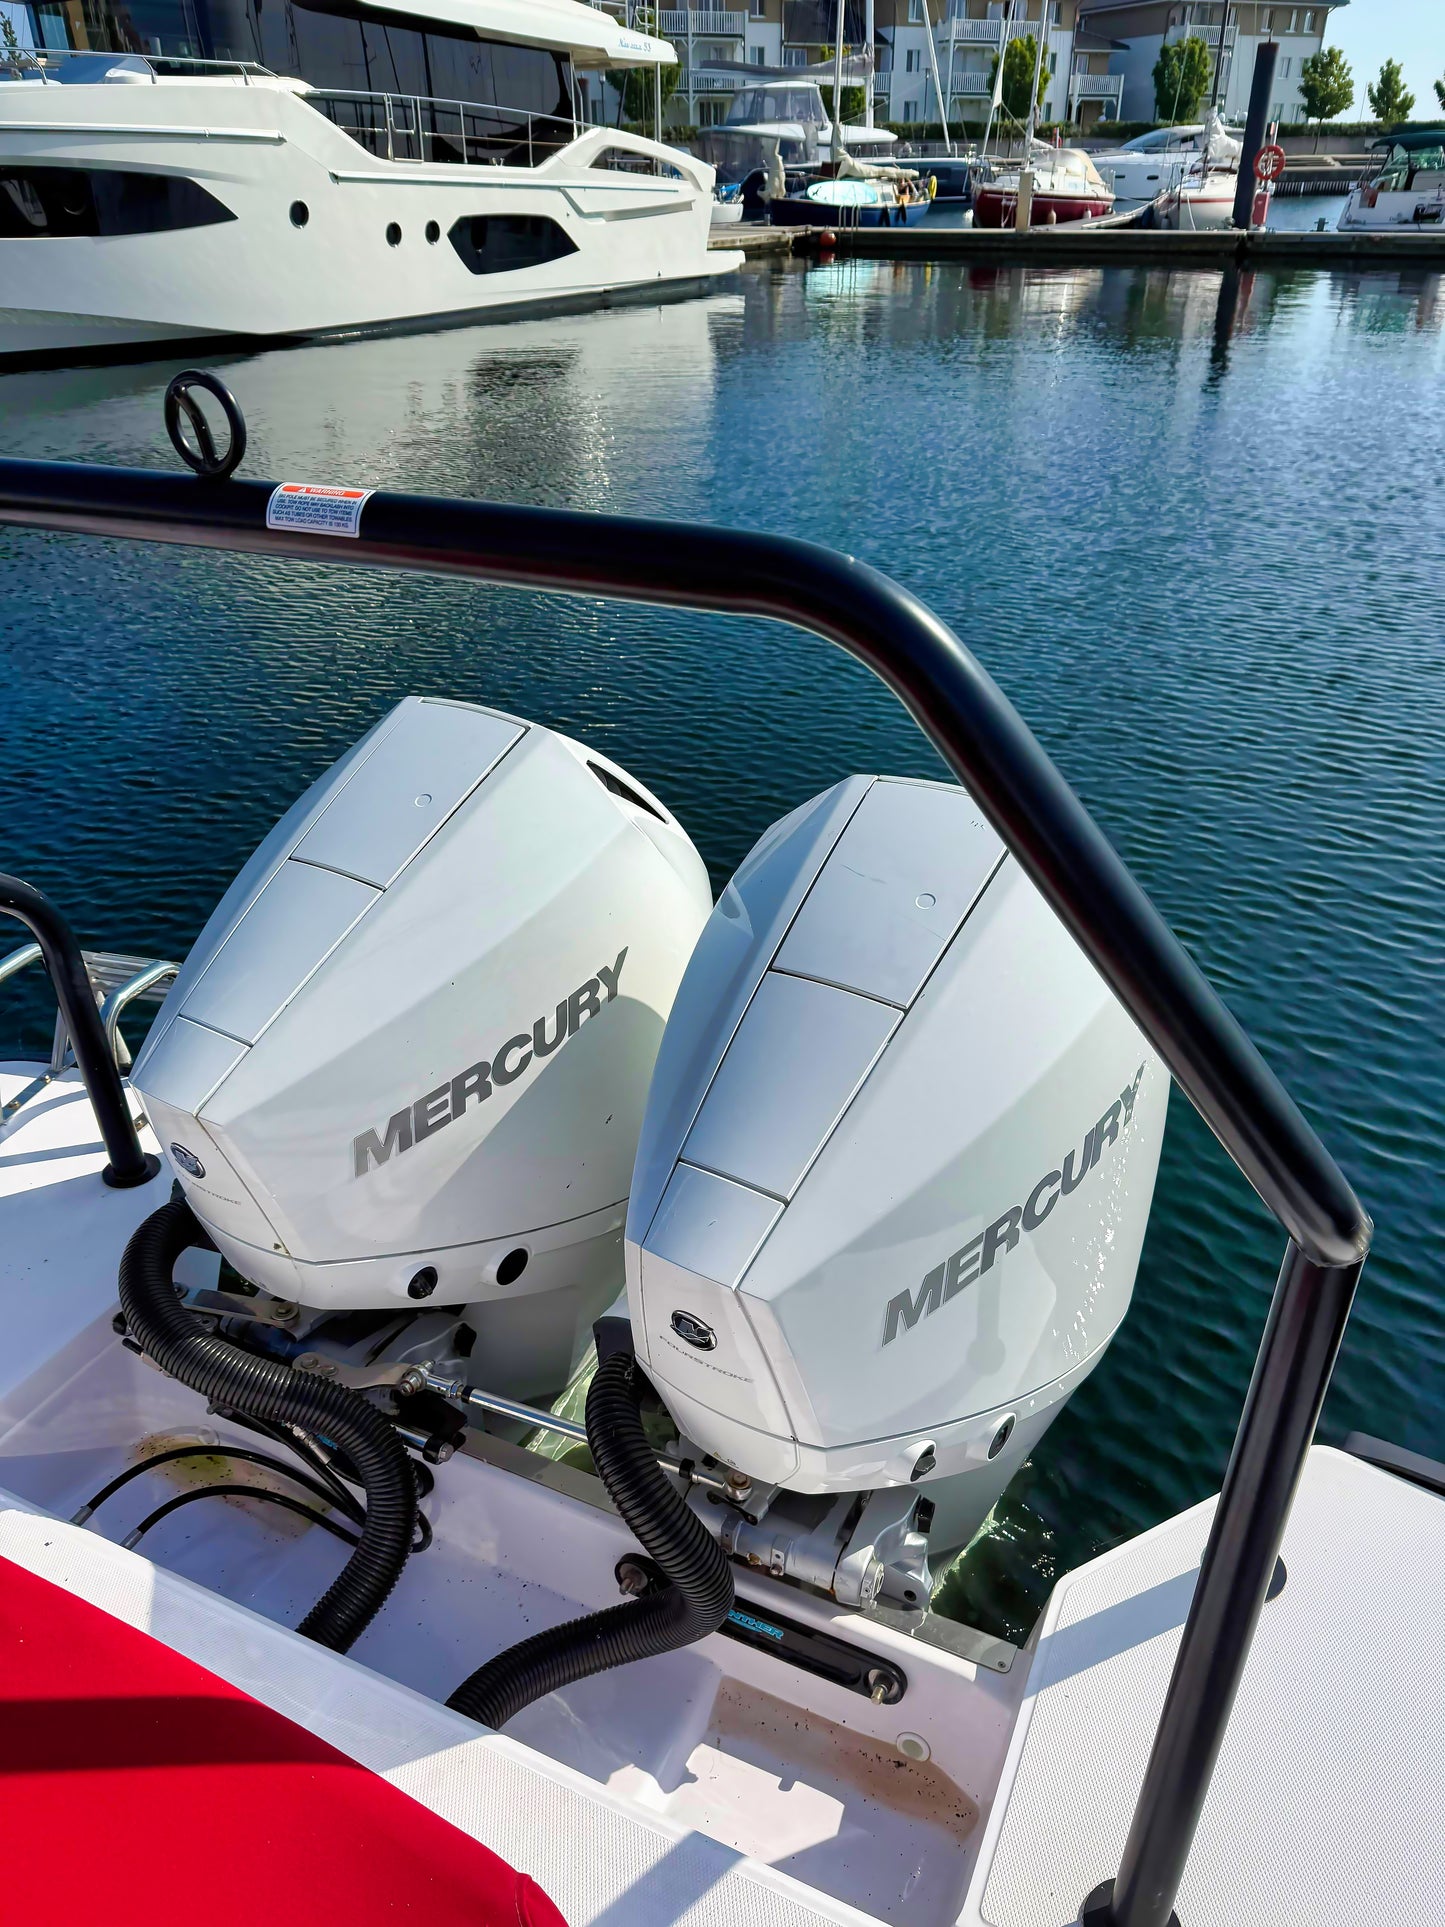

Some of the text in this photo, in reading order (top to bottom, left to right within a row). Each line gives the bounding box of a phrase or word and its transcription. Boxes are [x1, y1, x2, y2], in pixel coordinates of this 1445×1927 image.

[310, 487, 345, 496] WARNING
[354, 946, 628, 1178] MERCURY
[177, 1169, 242, 1206] STROKE
[882, 1060, 1146, 1347] MERCURY
[659, 1335, 755, 1384] FOURSTROKE
[728, 1609, 784, 1640] NTHER
